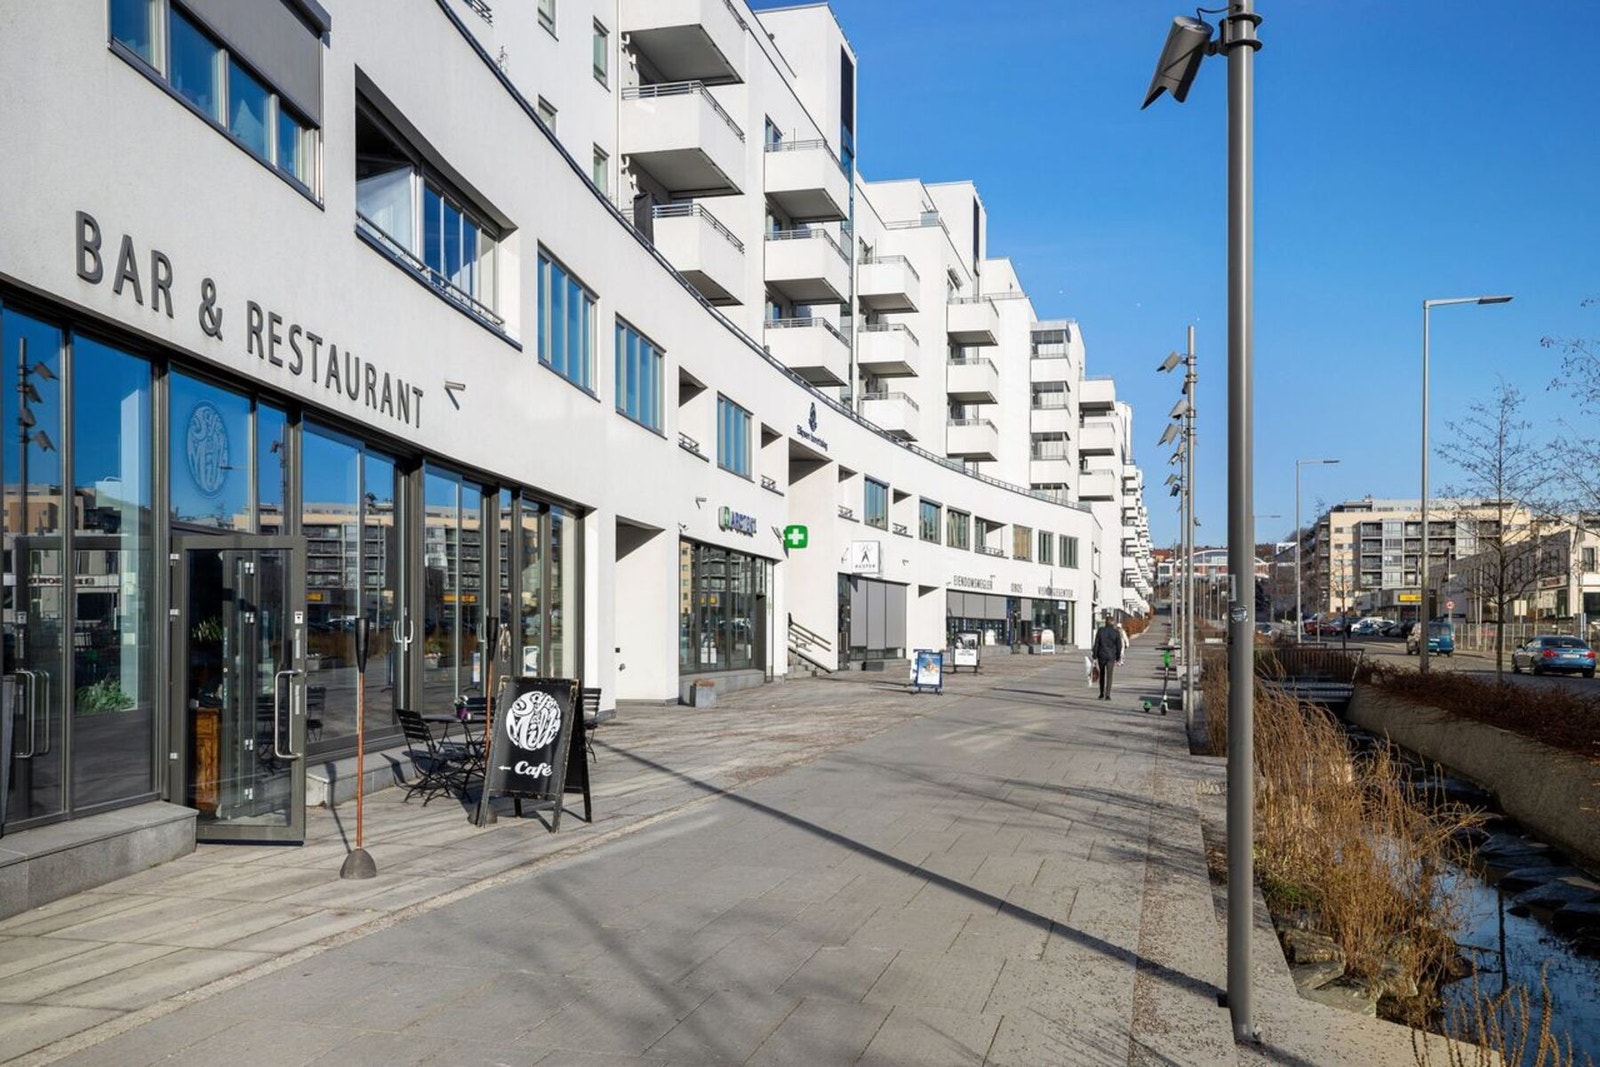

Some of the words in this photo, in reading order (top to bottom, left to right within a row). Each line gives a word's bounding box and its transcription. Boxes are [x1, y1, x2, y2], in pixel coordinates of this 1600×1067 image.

[75, 210, 174, 319] BAR
[198, 277, 224, 341] &
[246, 300, 425, 429] RESTAURANT
[514, 760, 553, 779] Café
